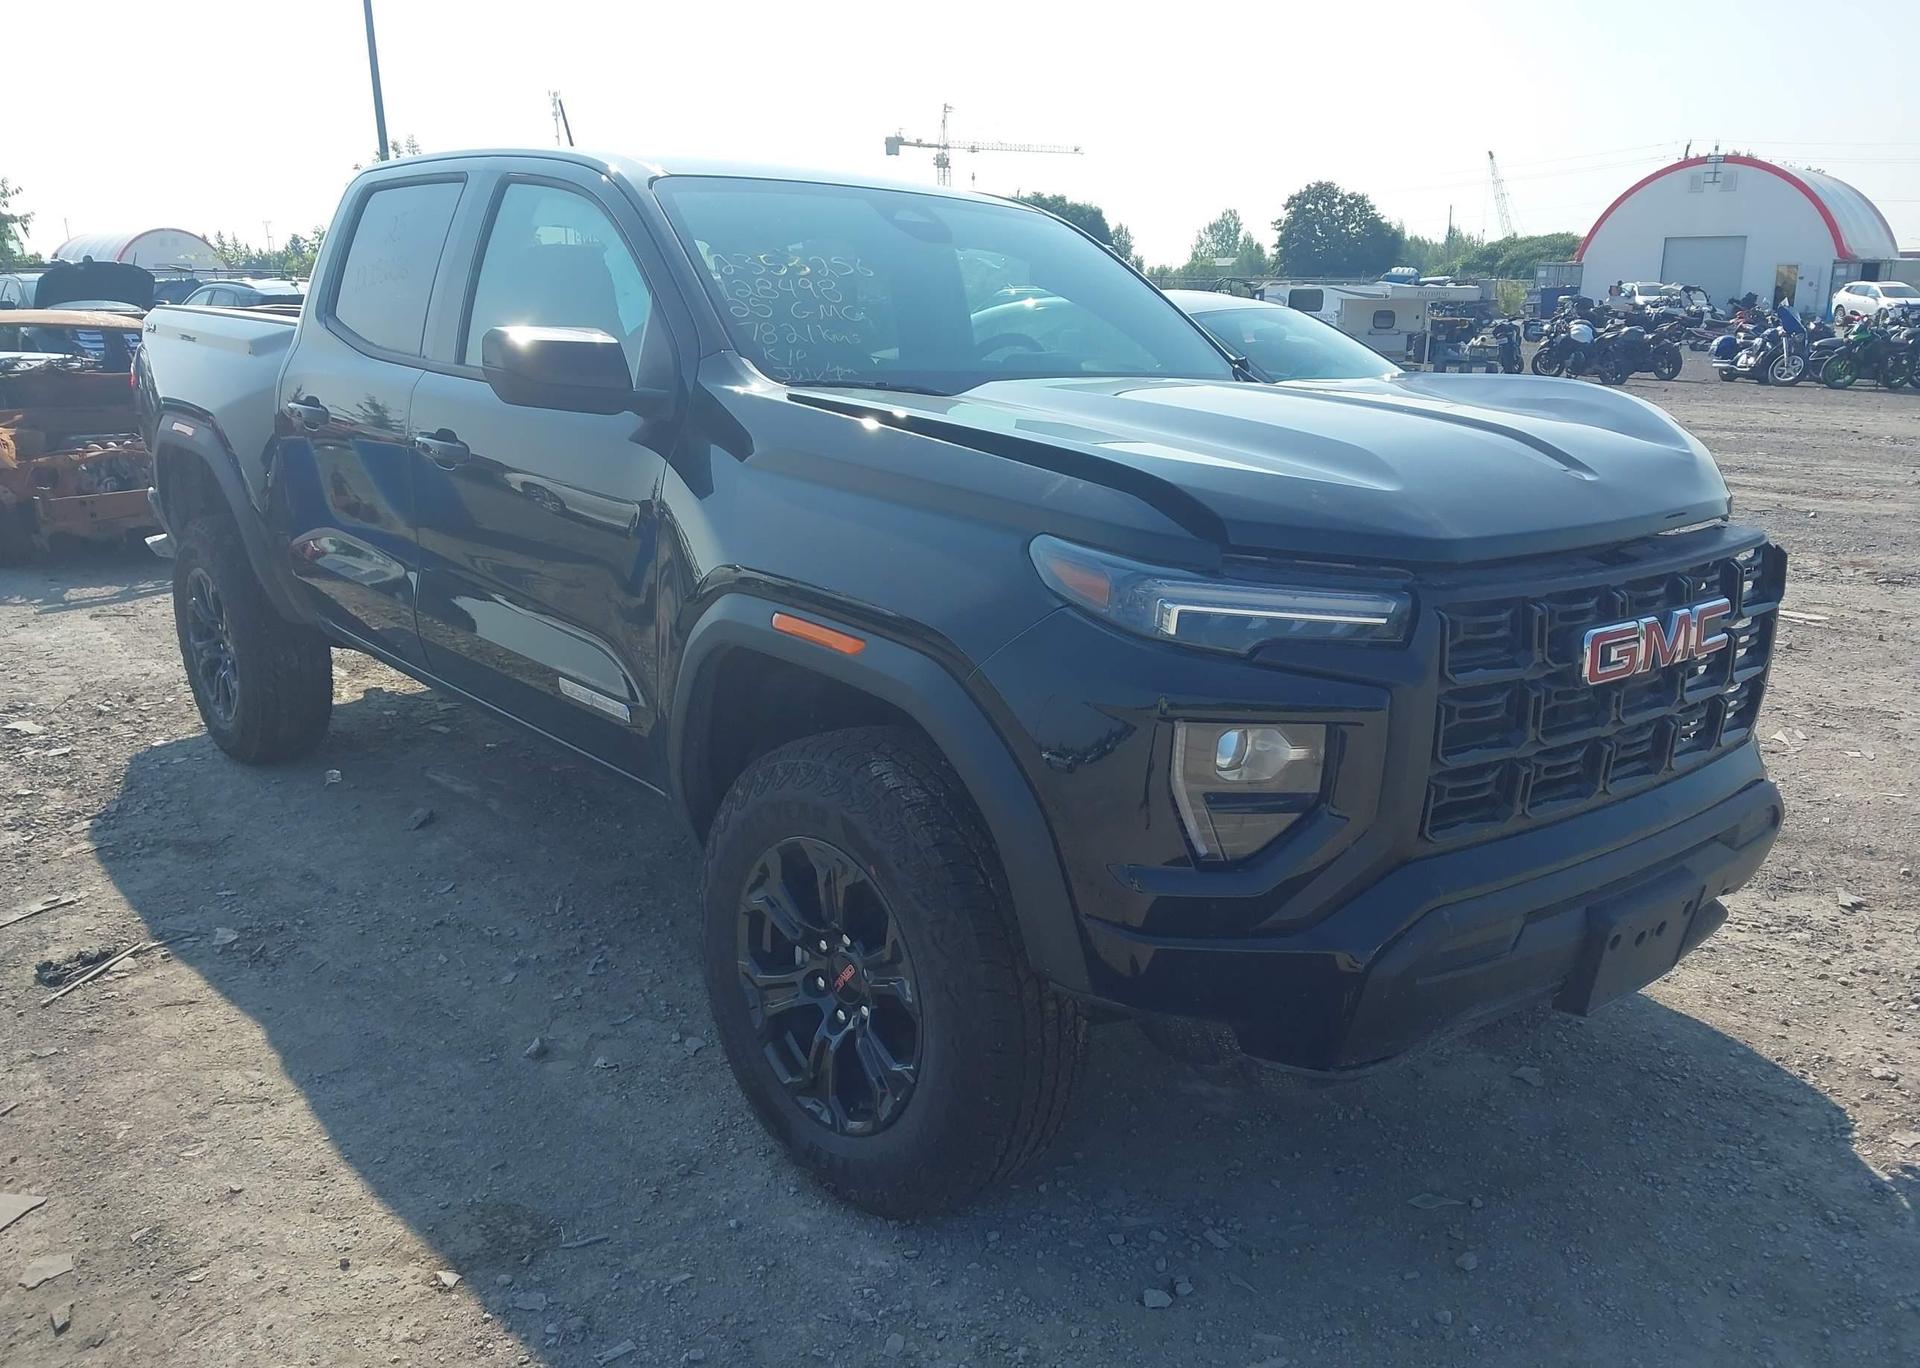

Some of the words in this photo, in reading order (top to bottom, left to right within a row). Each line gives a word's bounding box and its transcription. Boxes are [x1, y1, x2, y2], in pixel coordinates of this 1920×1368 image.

[790, 301, 866, 322] GMC
[1582, 598, 1731, 685] GMC
[834, 964, 856, 993] GMC
